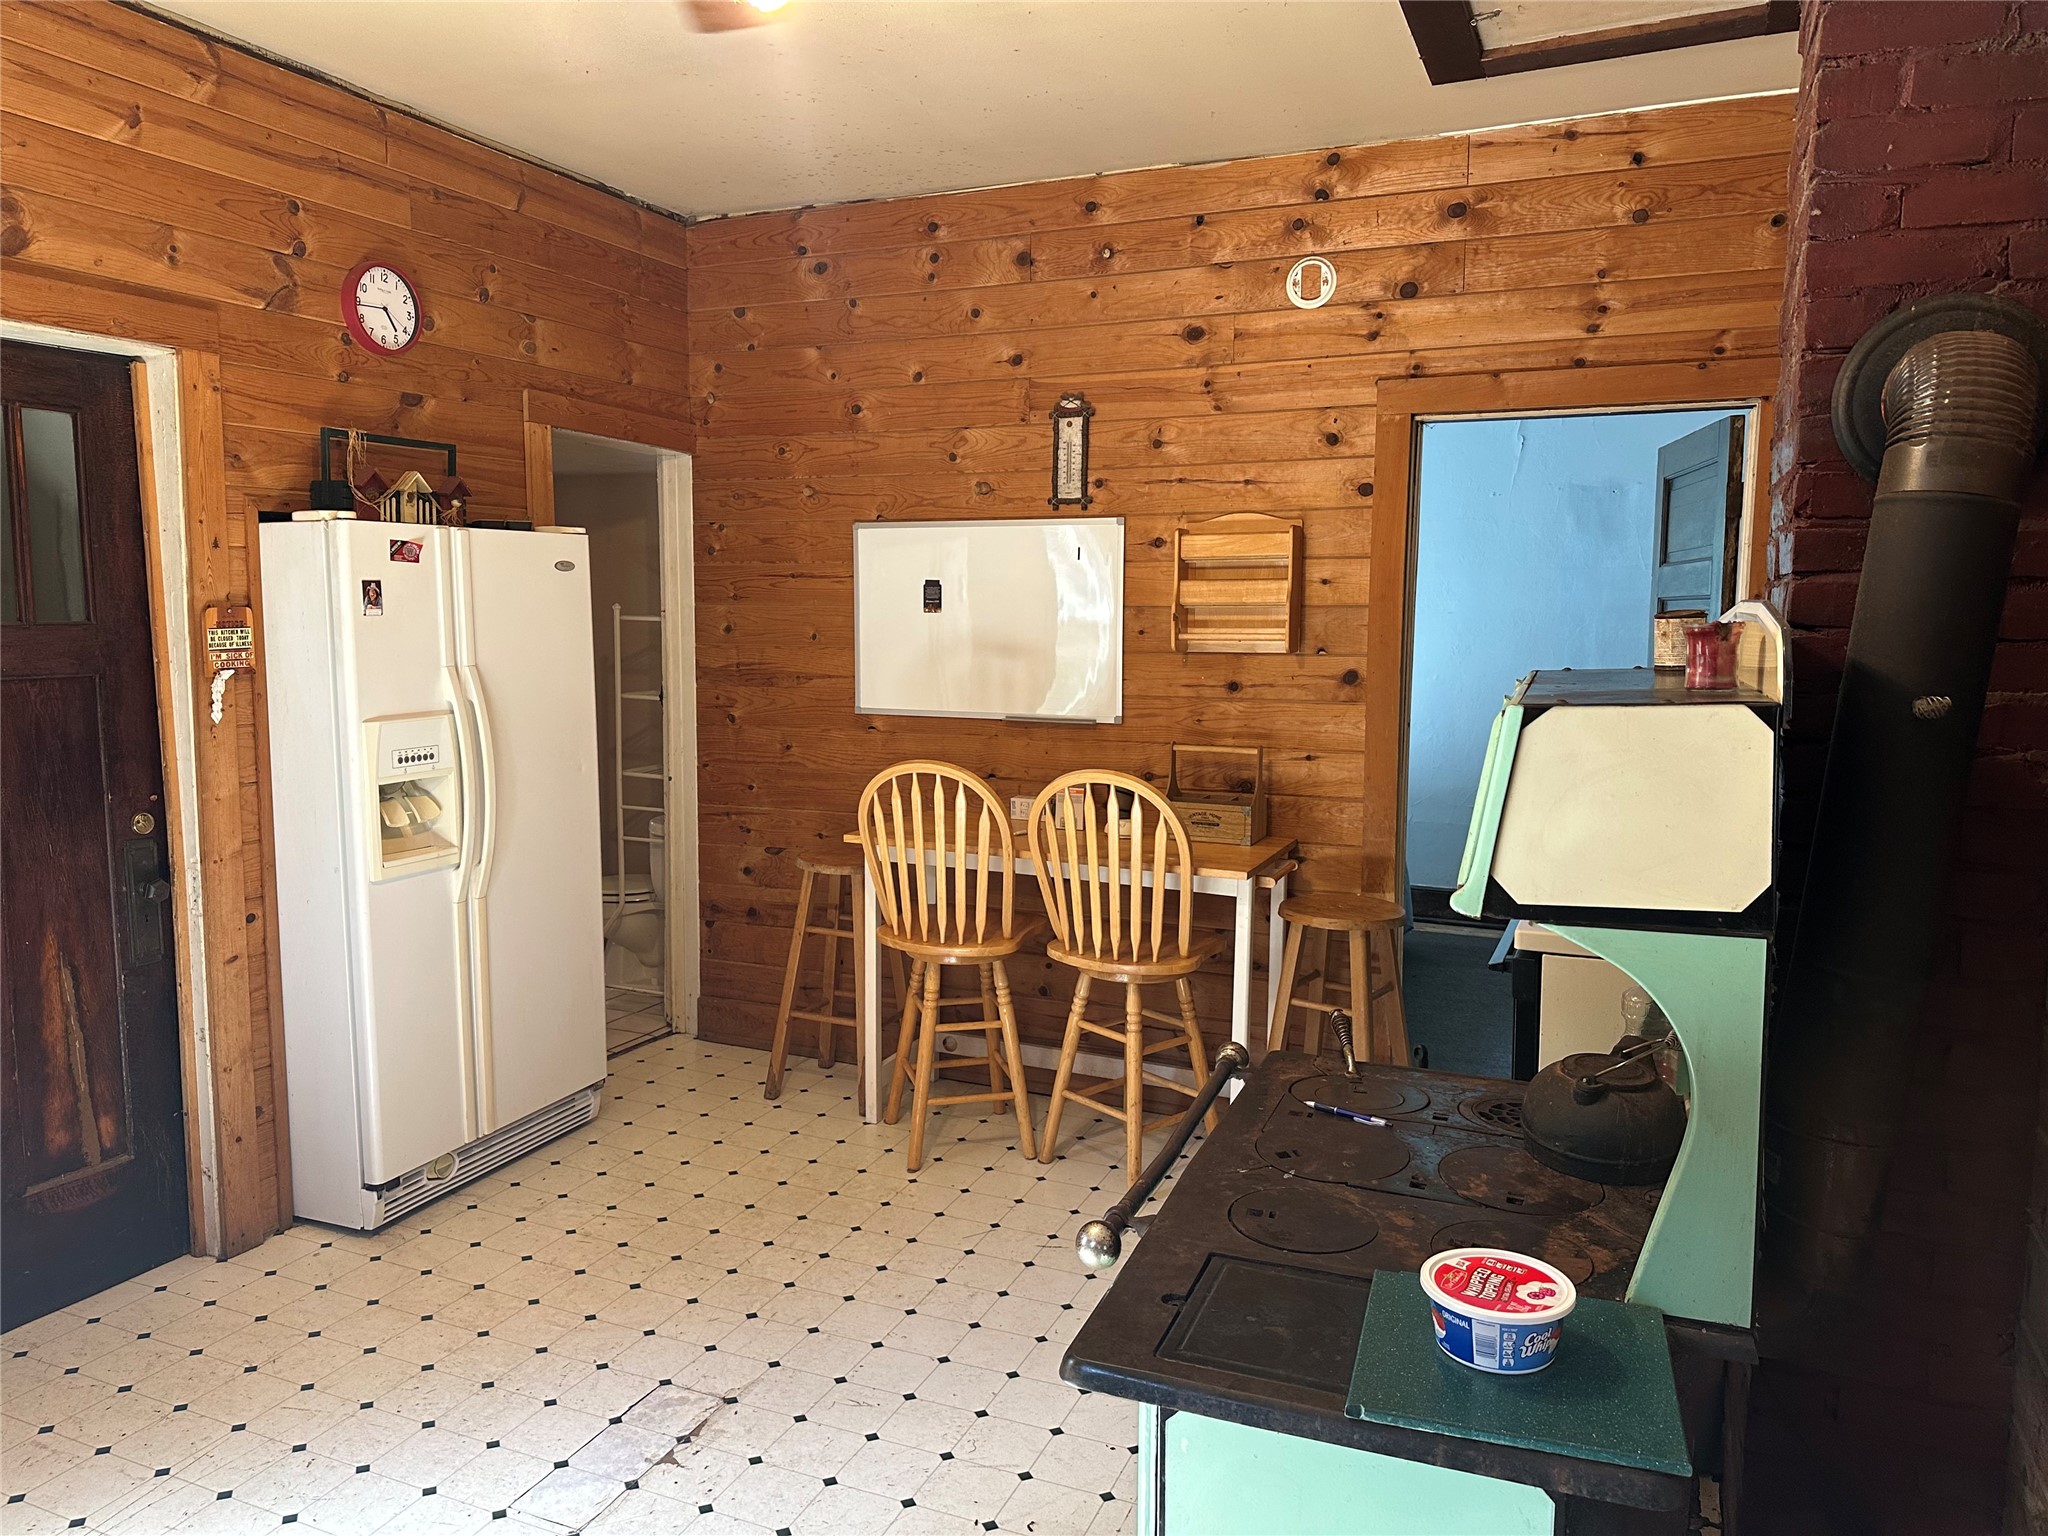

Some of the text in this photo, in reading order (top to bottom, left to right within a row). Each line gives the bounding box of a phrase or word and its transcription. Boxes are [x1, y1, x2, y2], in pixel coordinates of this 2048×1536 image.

[370, 273, 375, 283] 11
[381, 273, 388, 283] 12
[360, 282, 367, 293] 10
[395, 281, 398, 290] 1
[356, 297, 361, 305] 9
[403, 295, 408, 304] 2
[360, 314, 365, 323] 8
[407, 311, 412, 320] 3
[369, 327, 374, 336] 7
[402, 327, 407, 335] 4
[381, 335, 386, 344] 6
[394, 335, 398, 344] 5
[1460, 1267, 1492, 1297] WHIPPED
[1478, 1273, 1505, 1300] TOPPING
[1441, 1310, 1471, 1330] ORIGINAL
[1524, 1327, 1552, 1347] Cool
[1519, 1337, 1553, 1358] Whip
